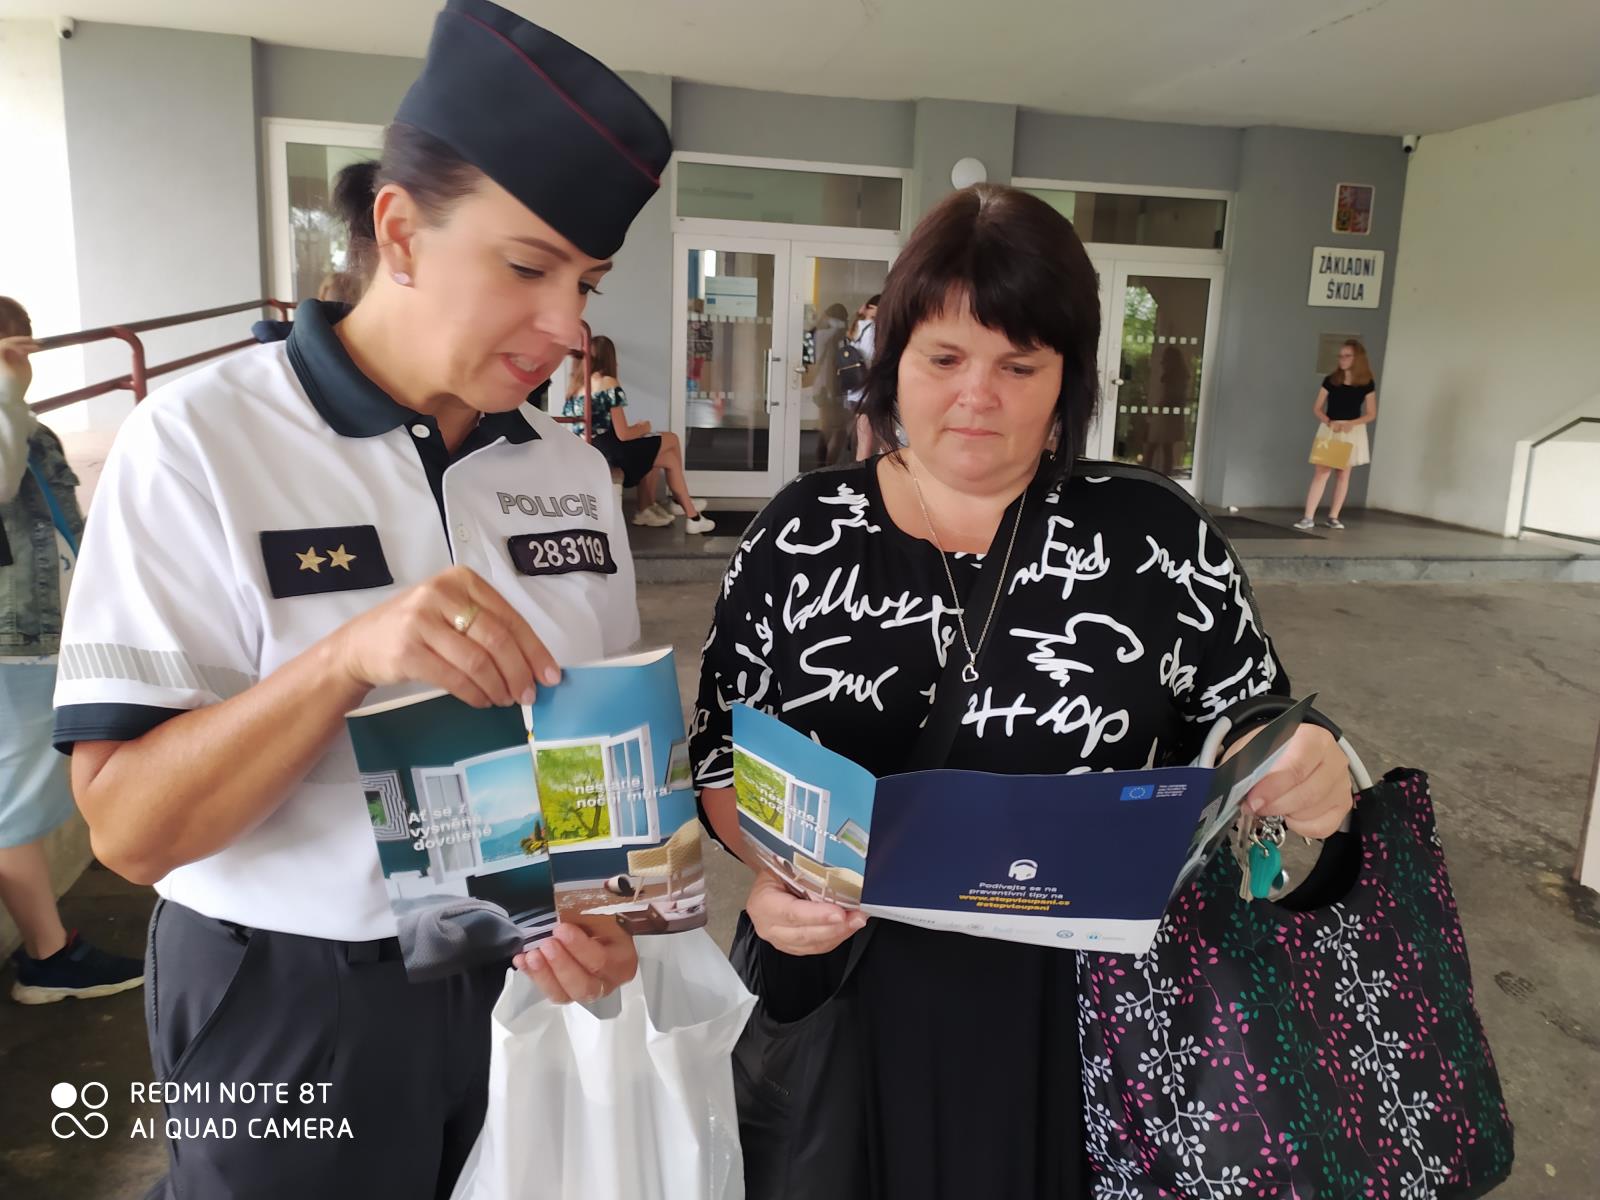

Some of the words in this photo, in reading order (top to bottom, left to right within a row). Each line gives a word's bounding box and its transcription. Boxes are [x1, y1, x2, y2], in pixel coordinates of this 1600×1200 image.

[1319, 253, 1377, 276] ZÁKLADNÍ
[1326, 278, 1365, 301] ŠKOLA
[496, 491, 599, 520] POLICIE
[528, 535, 605, 568] 283119
[1028, 890, 1048, 900] tipy
